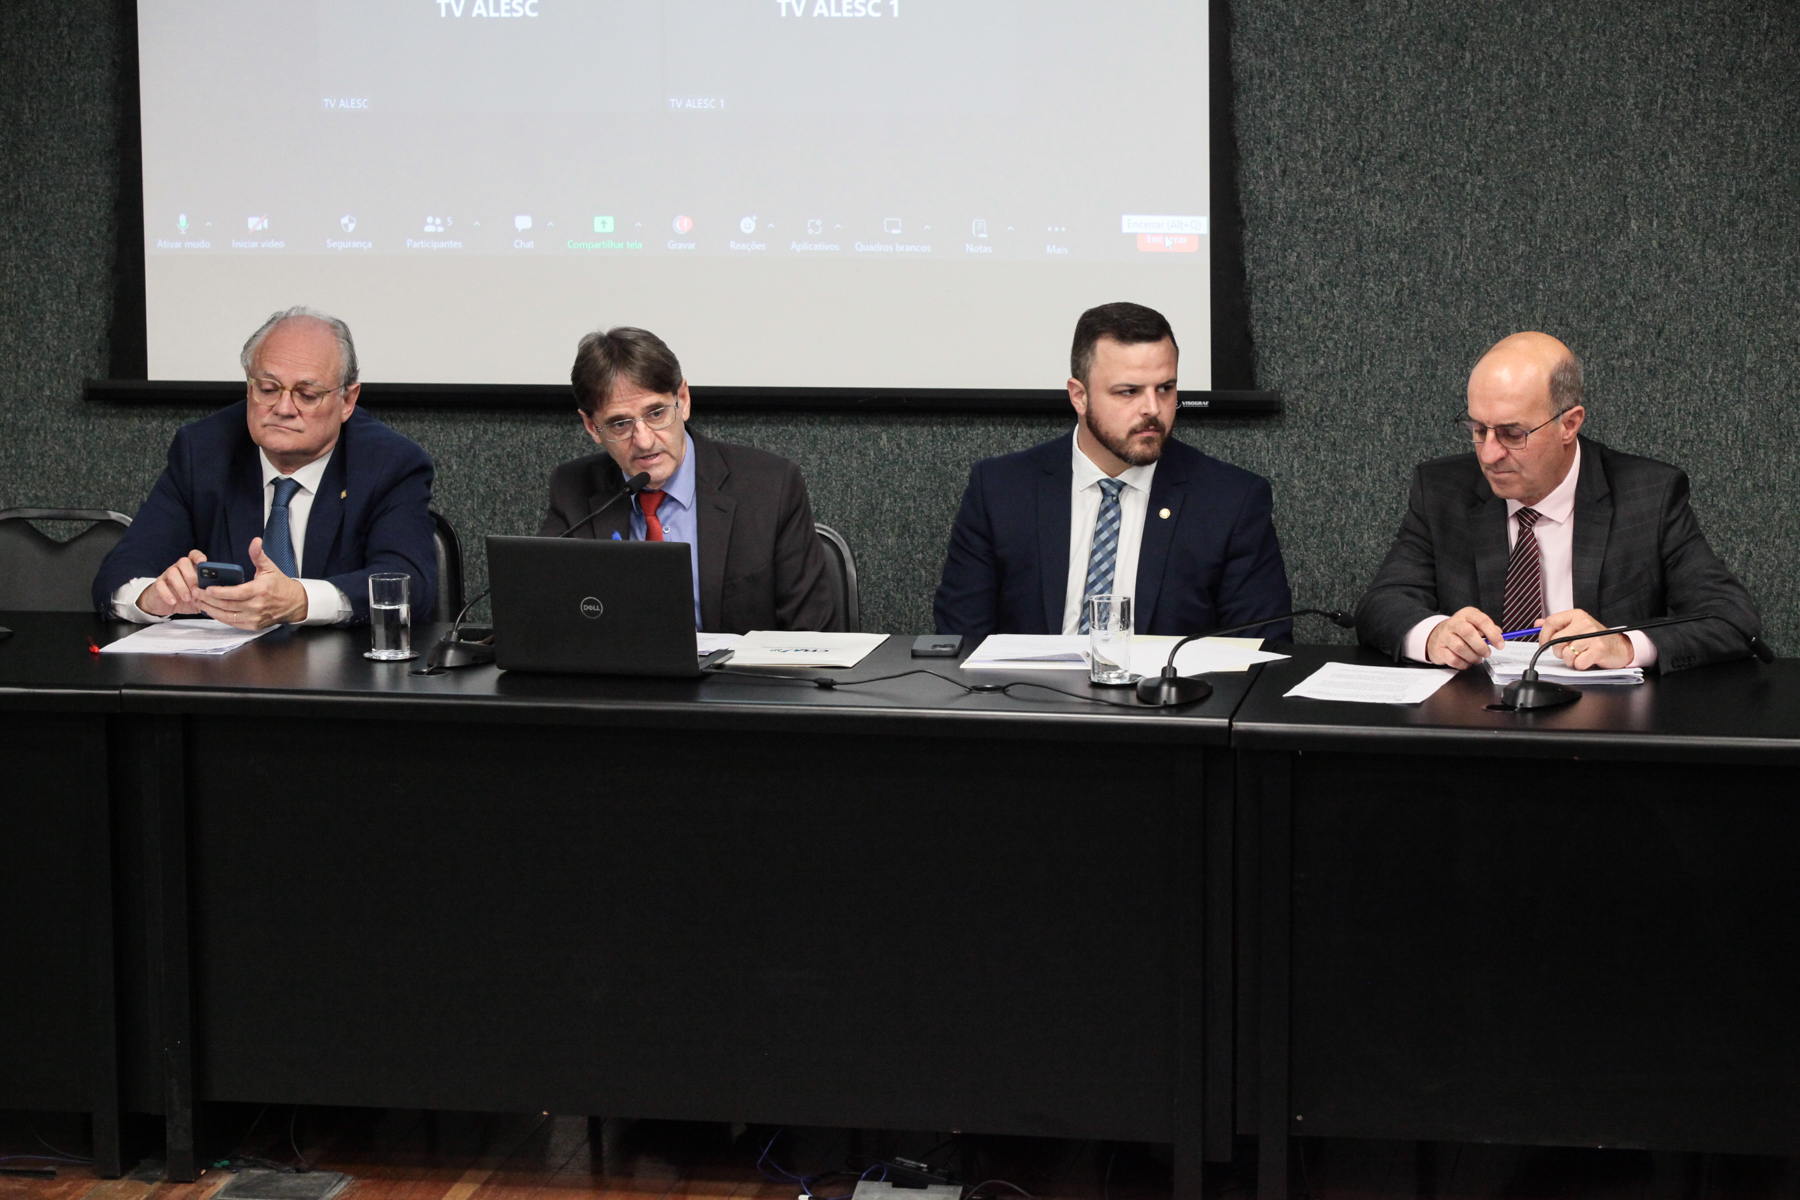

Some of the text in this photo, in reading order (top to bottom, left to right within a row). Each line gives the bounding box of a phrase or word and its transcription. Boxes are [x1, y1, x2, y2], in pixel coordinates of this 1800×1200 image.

[436, 0, 539, 18] TV ALESC
[776, 0, 899, 18] TV ALESC 1
[323, 98, 368, 109] TV ALESC
[669, 98, 725, 109] TV ALESC 1
[156, 239, 211, 249] Ativar mudo
[231, 239, 259, 249] Iniciar
[326, 239, 373, 251] Segurança
[406, 239, 463, 251] Participantes
[513, 239, 535, 249] Chat
[567, 239, 643, 251] Compartilhar tela
[667, 240, 697, 250] Gravar
[729, 240, 767, 253] Reações
[790, 241, 840, 254] Aplicativos
[854, 242, 932, 254] Quadros brancos
[965, 243, 993, 254] Notas
[1046, 244, 1069, 255] Mais
[583, 604, 601, 612] DELL
